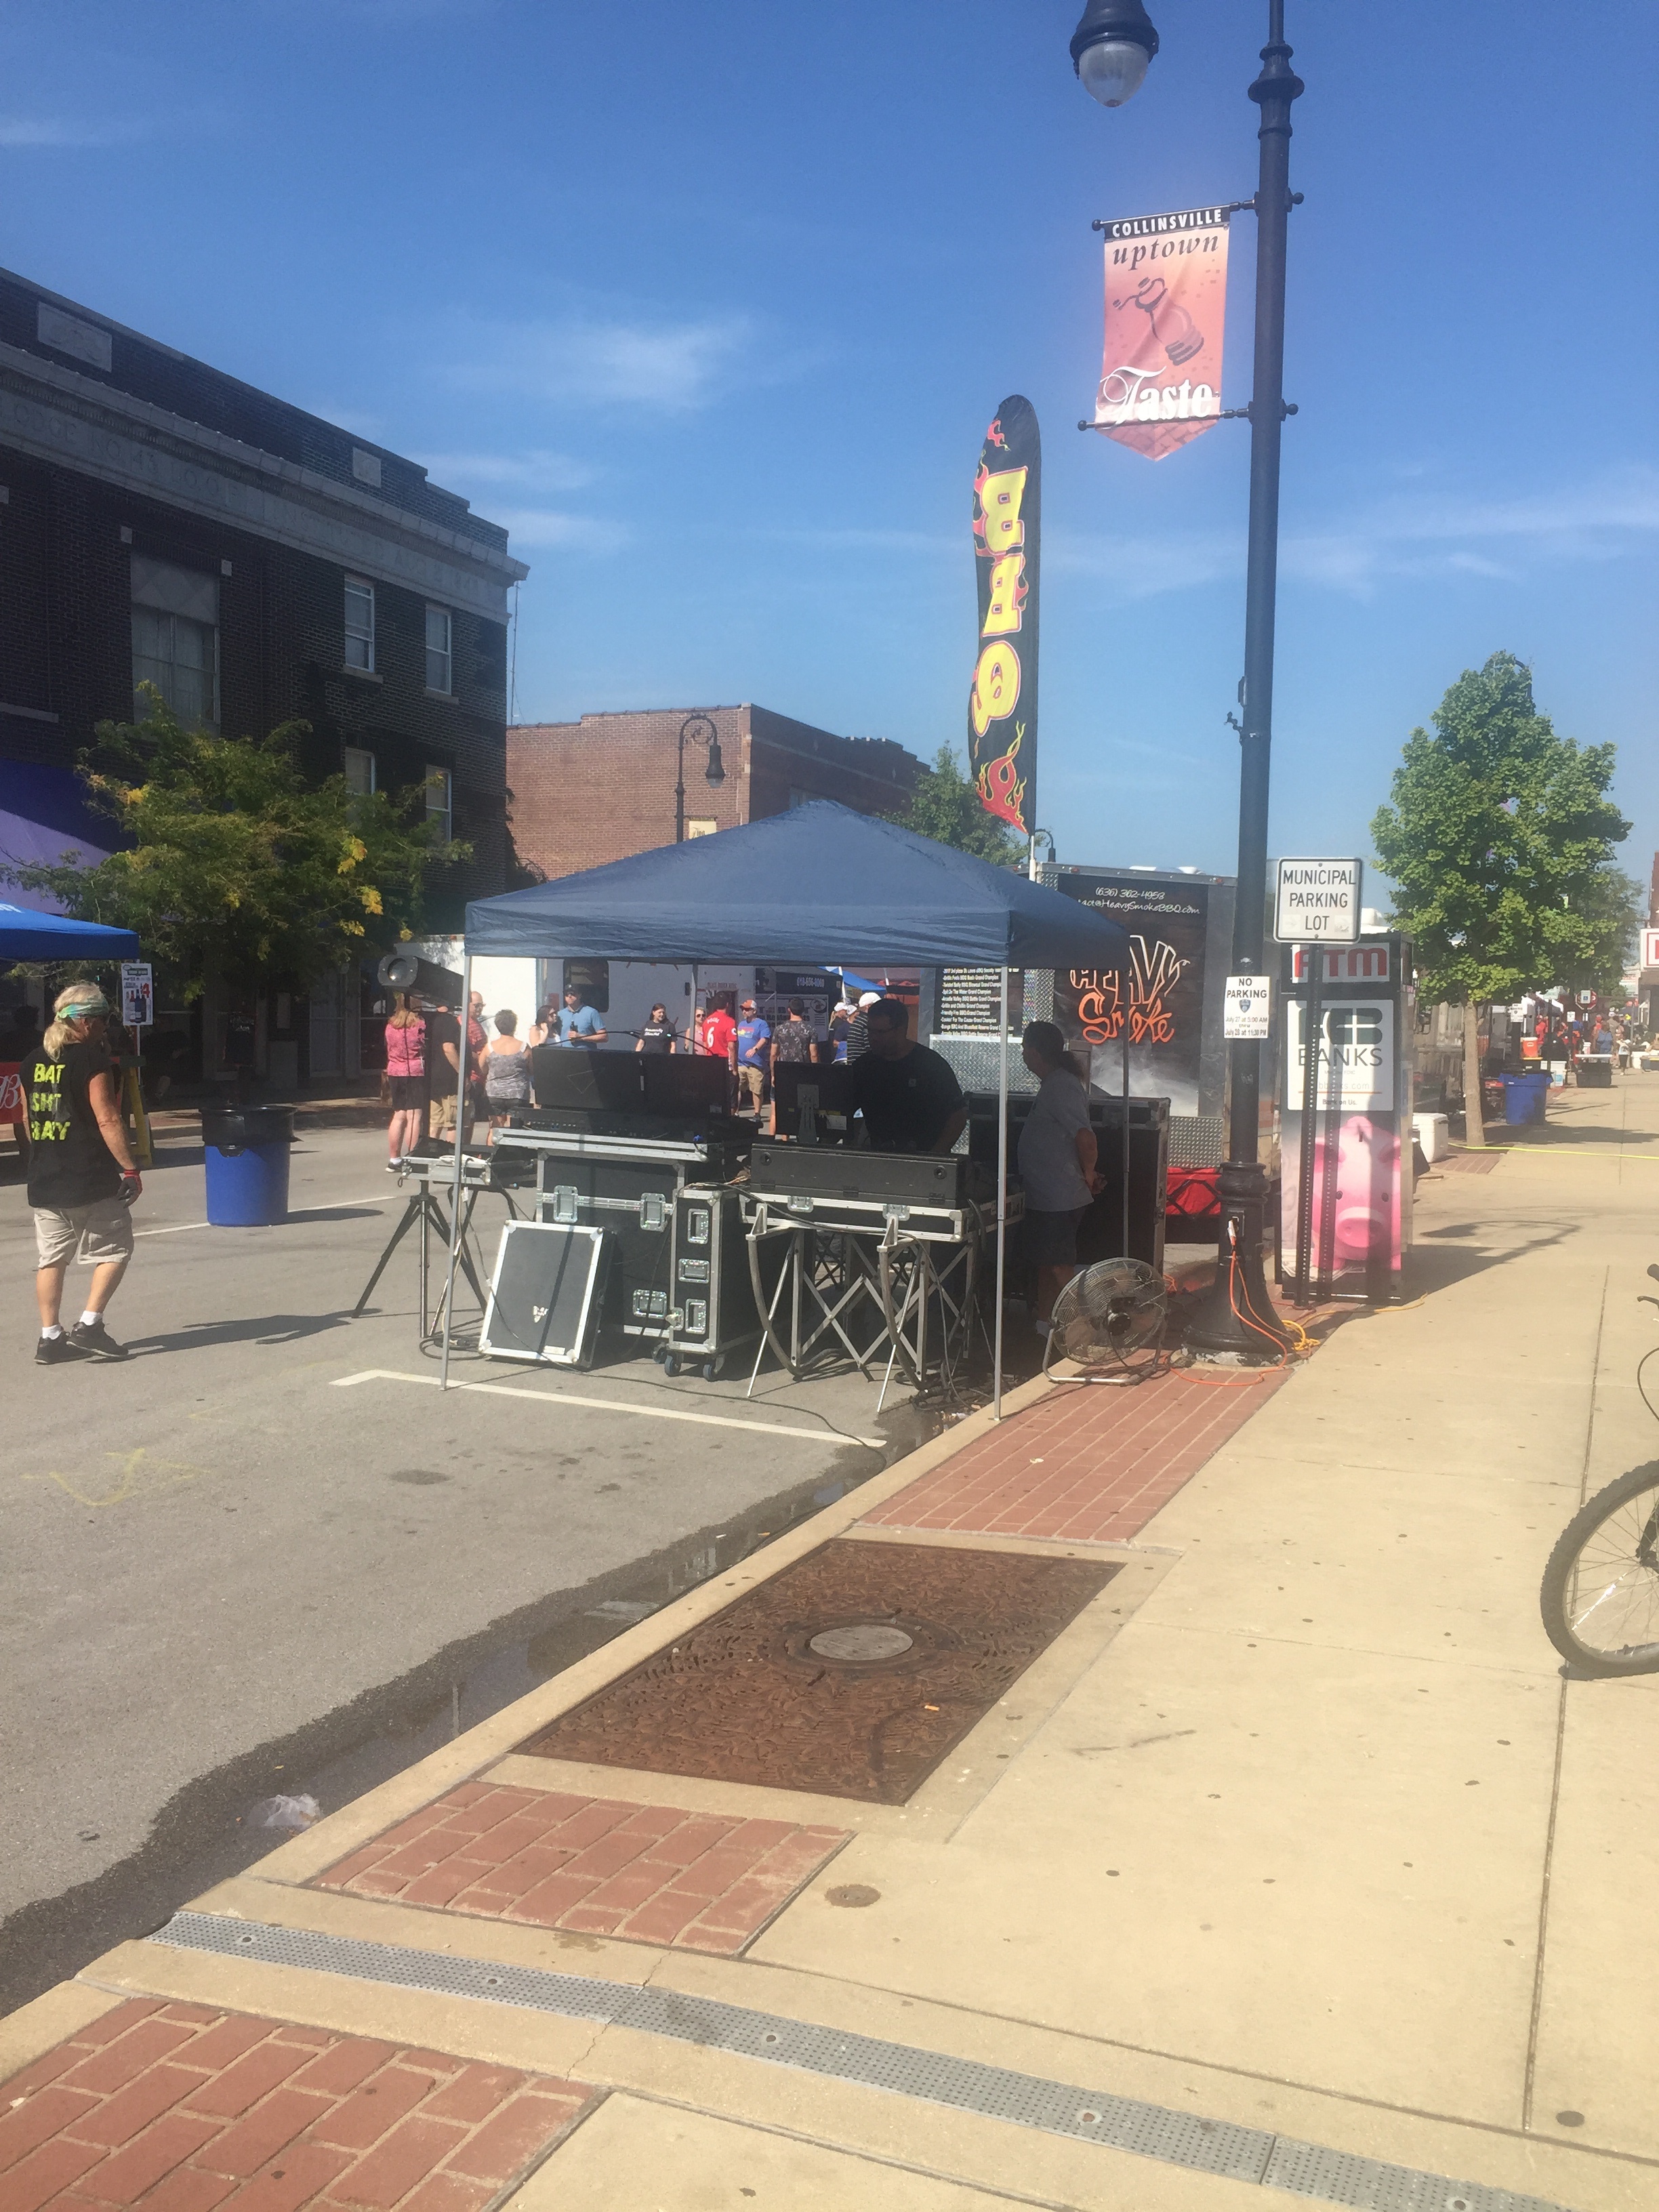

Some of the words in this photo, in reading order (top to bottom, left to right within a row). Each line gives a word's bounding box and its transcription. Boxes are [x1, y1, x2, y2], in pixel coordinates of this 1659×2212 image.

[1112, 208, 1222, 238] COLLINSVILLE
[1113, 235, 1219, 271] uptown
[1095, 365, 1214, 425] Taste
[1283, 869, 1356, 885] MUNICIPAL
[1095, 886, 1118, 897] (636)
[1289, 893, 1348, 908] PARKING
[1305, 915, 1330, 930] LOT
[1239, 977, 1252, 986] NO
[1227, 989, 1267, 998] PARKING
[1079, 991, 1174, 1044] Smoke
[707, 1027, 714, 1048] 6
[1298, 1048, 1383, 1067] BANKS
[34, 1063, 66, 1084] BAT
